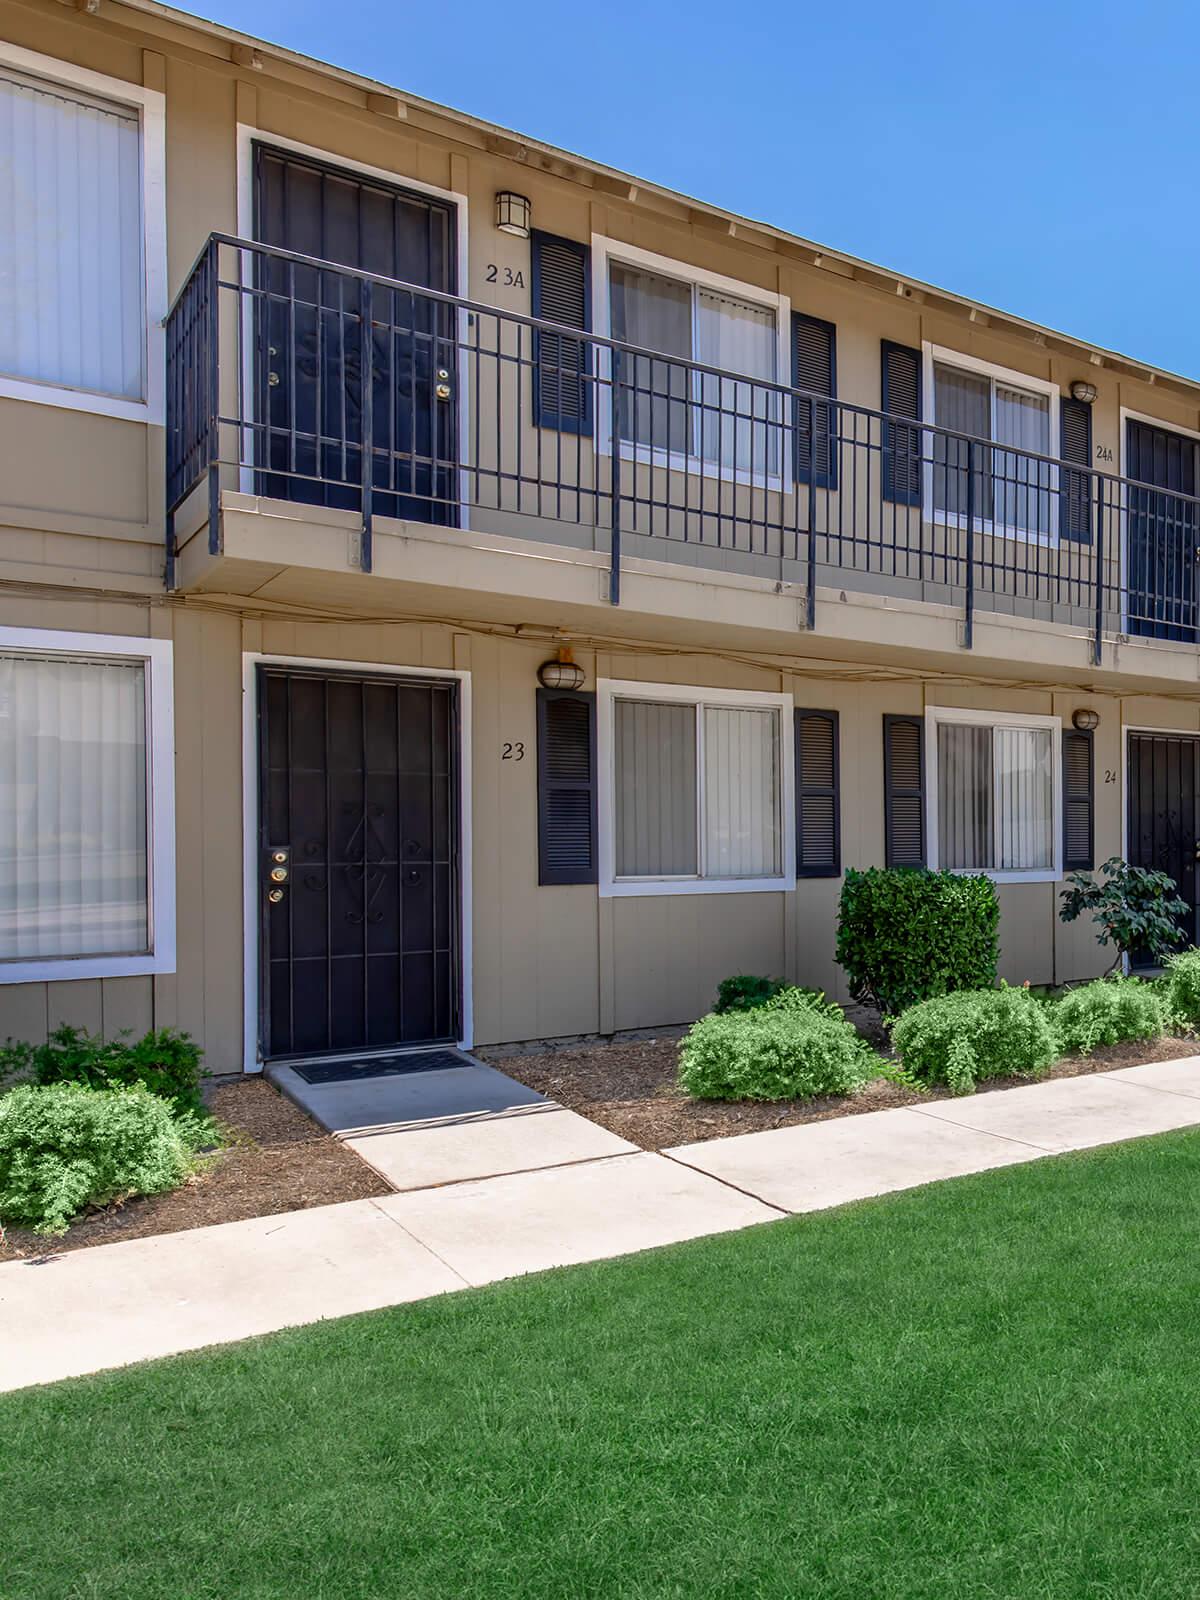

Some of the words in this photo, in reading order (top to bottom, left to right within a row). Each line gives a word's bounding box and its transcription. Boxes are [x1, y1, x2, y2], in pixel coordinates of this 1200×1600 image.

[486, 264, 525, 289] 23A
[1096, 445, 1113, 462] 24A
[502, 742, 524, 761] 23
[1104, 769, 1116, 784] 24
